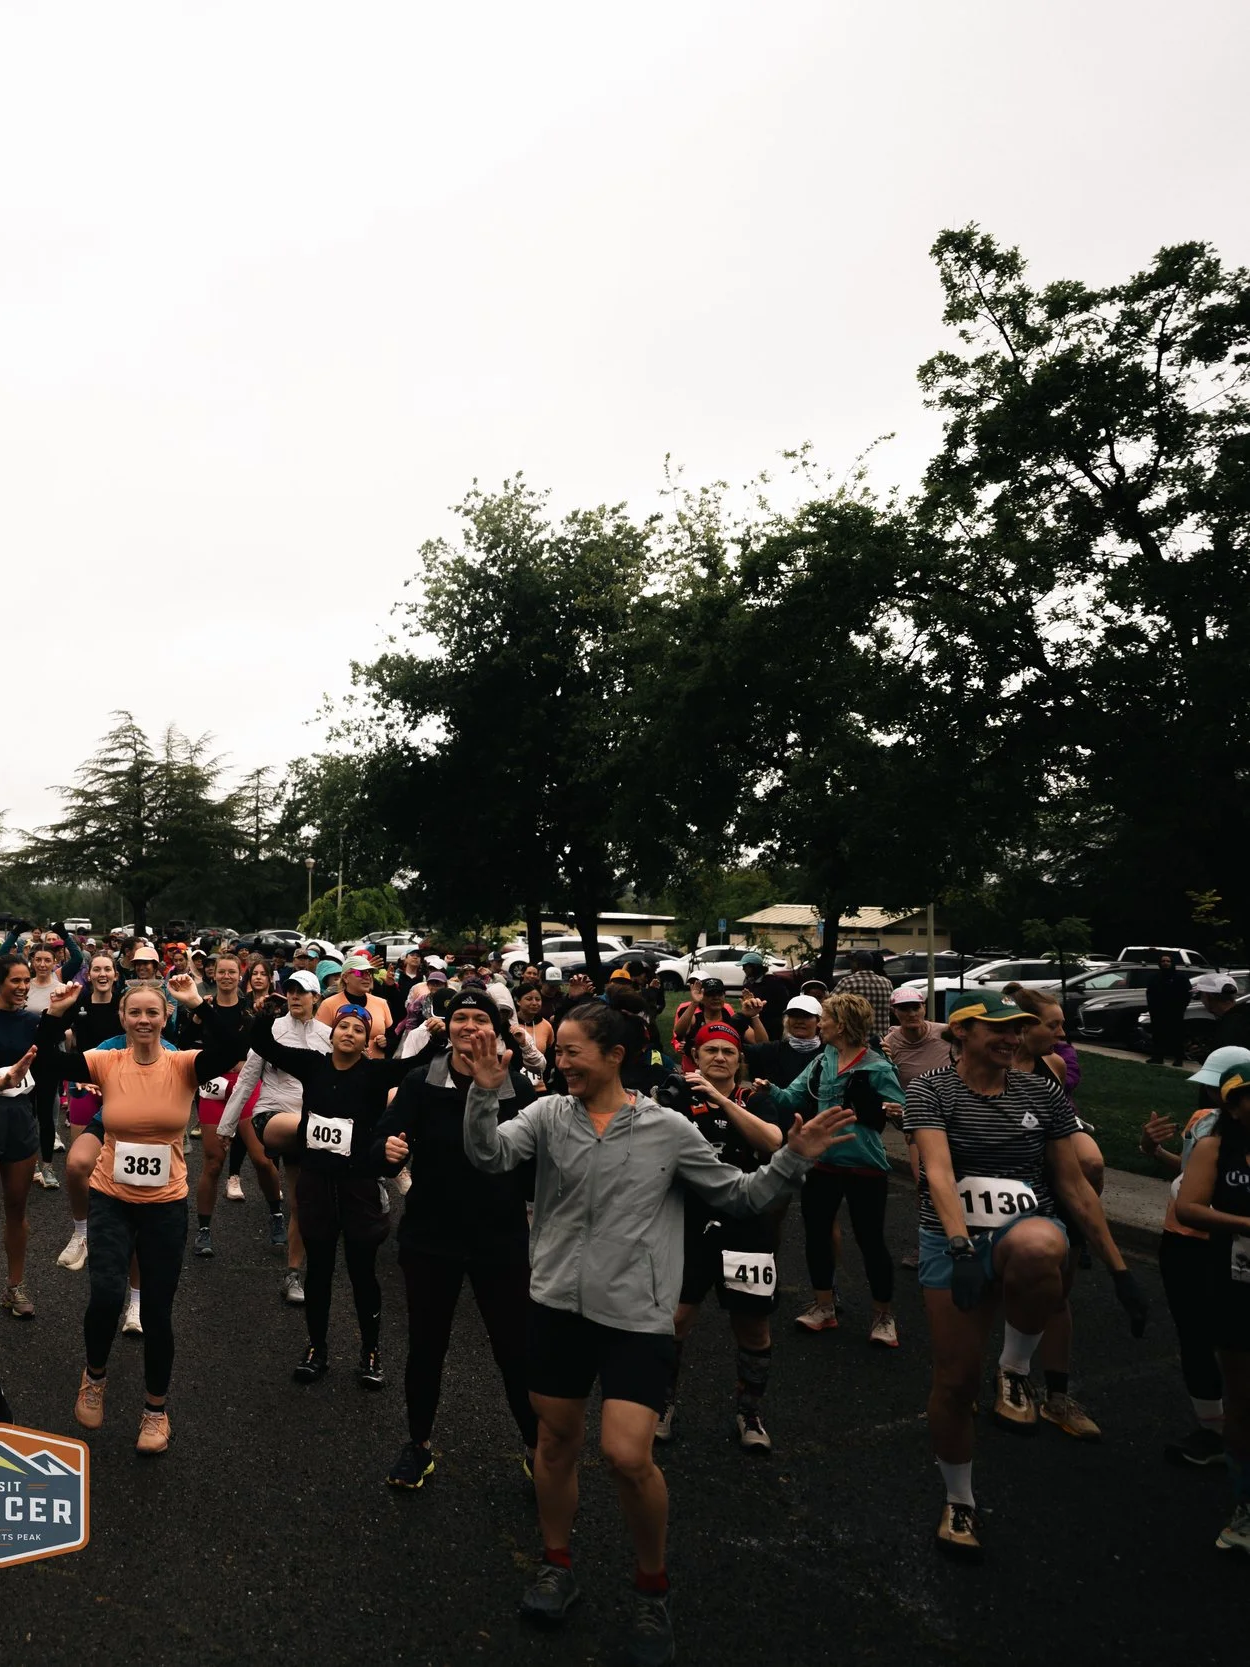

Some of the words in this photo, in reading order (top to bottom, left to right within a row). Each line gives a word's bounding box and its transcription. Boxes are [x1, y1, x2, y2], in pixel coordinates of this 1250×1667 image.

[313, 1125, 342, 1144] 403
[124, 1155, 161, 1175] 383
[960, 1189, 1036, 1214] 1130
[735, 1264, 773, 1285] 416
